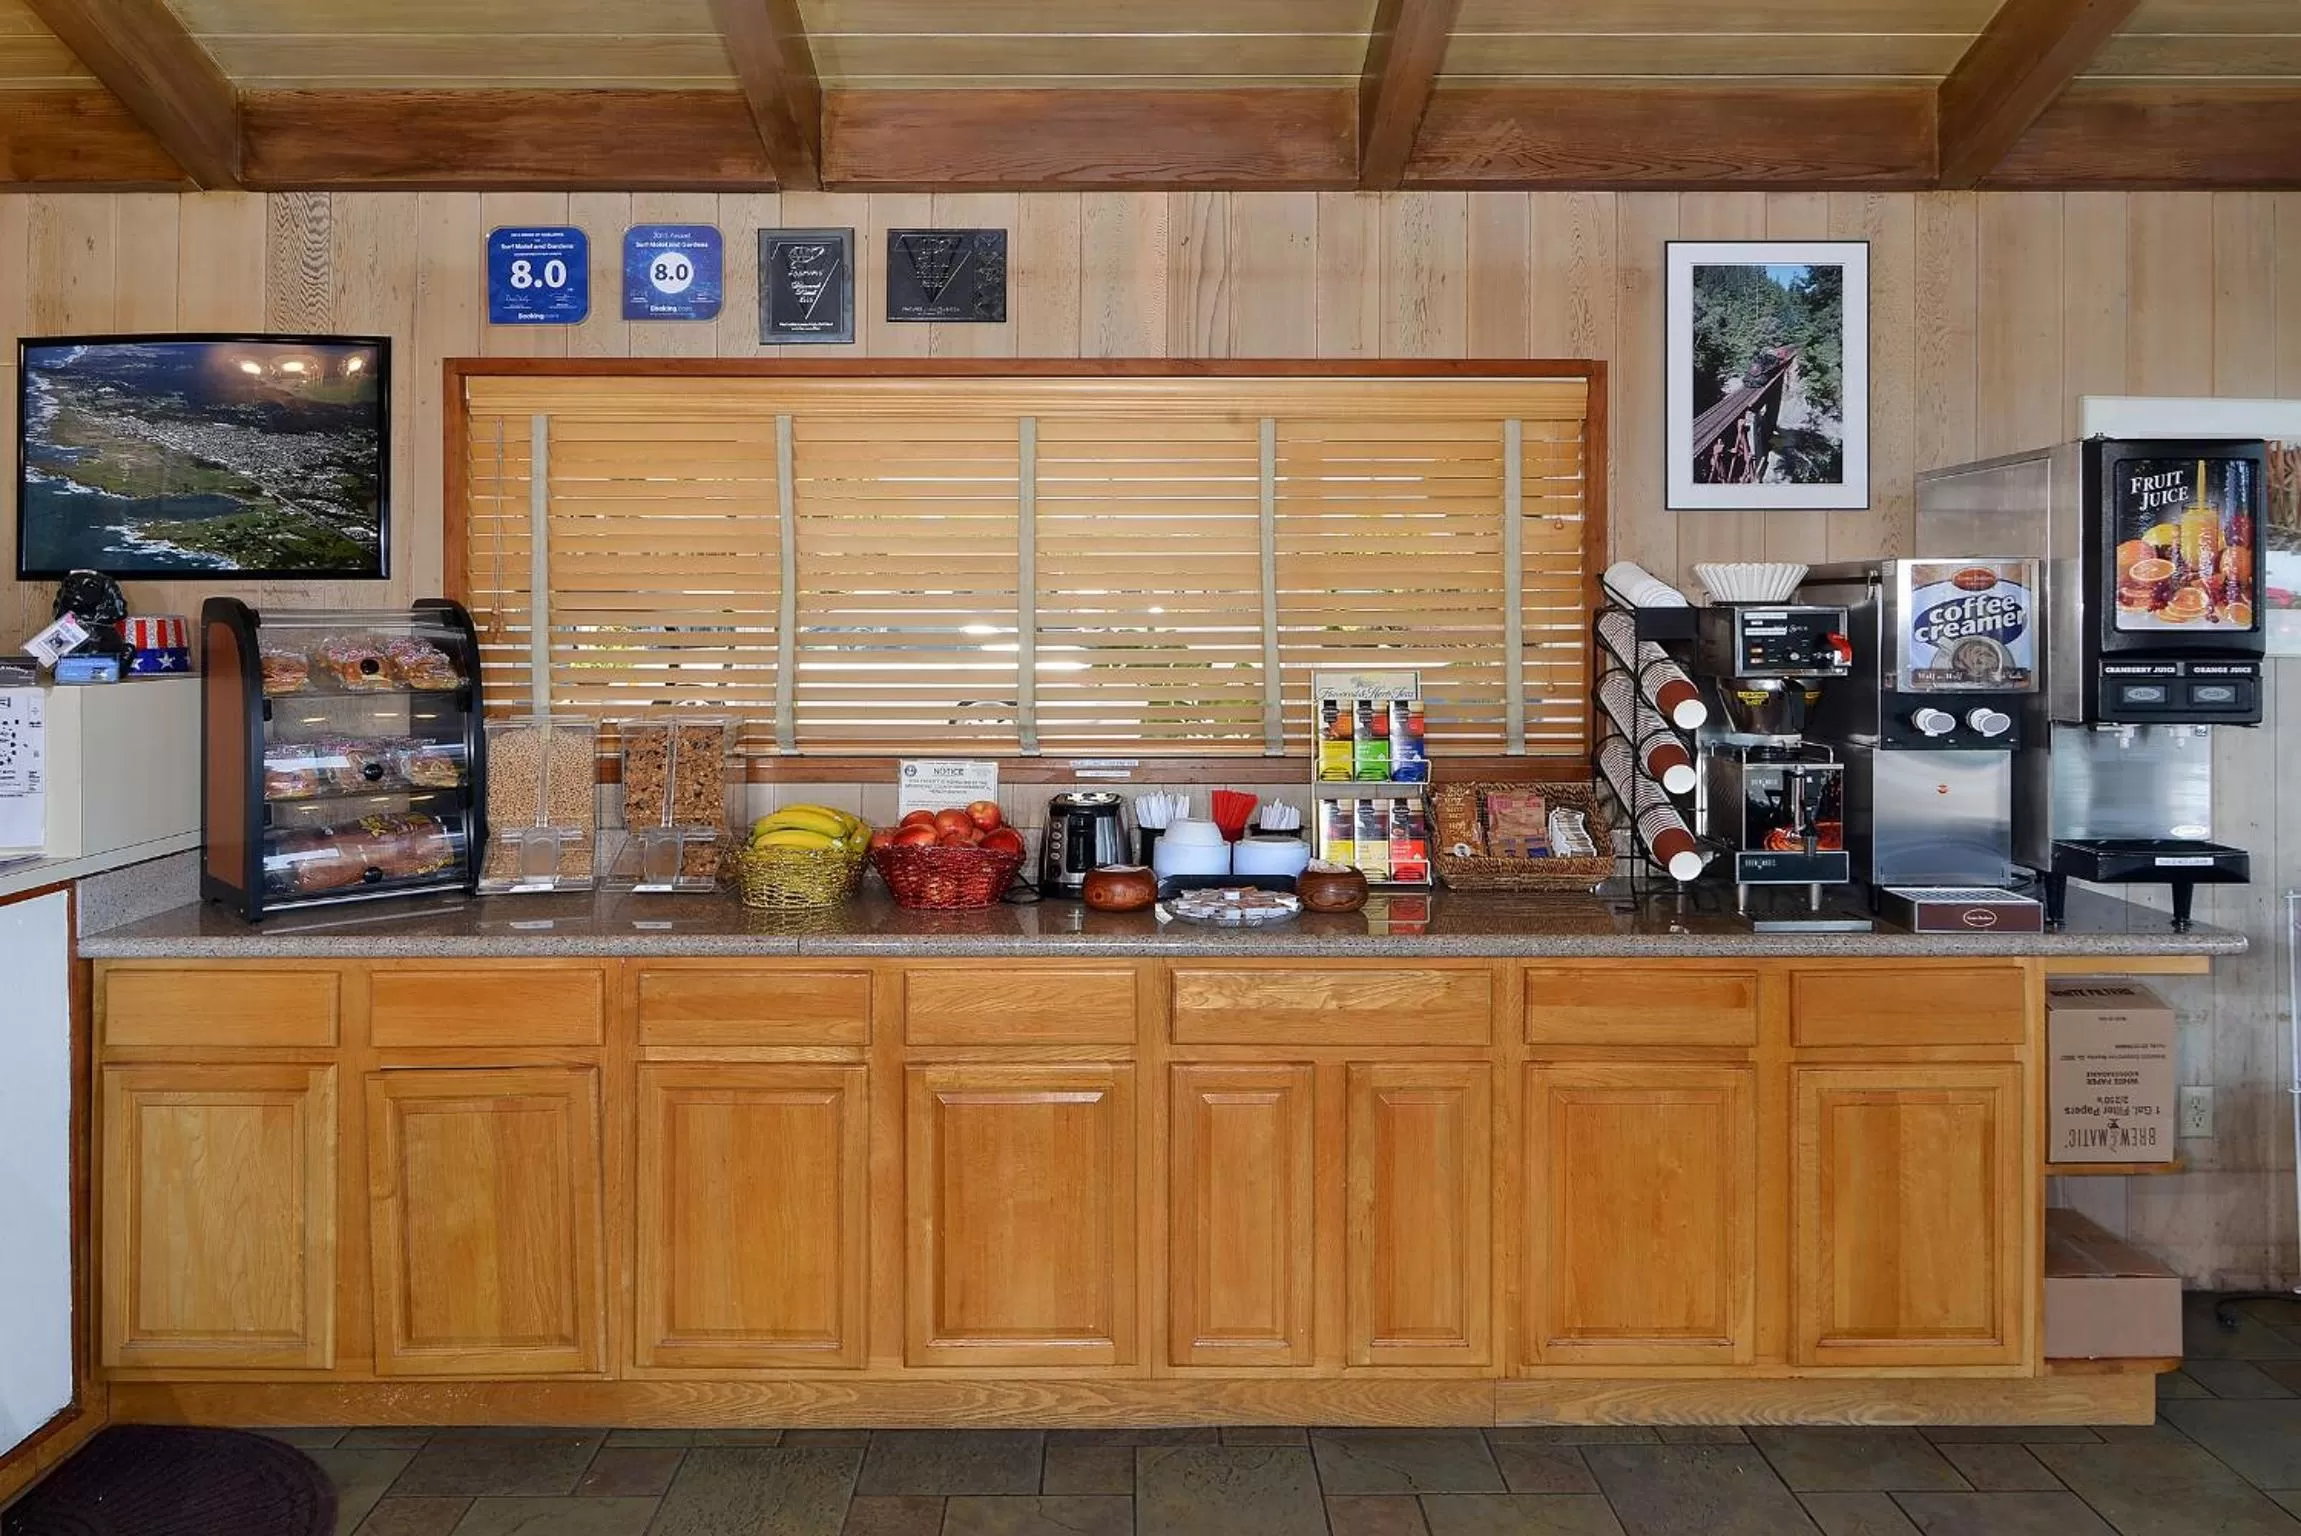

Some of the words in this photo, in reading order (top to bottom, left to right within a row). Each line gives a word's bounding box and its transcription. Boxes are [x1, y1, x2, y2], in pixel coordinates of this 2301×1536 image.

[510, 259, 567, 289] 8.0
[654, 263, 689, 281] 8.0
[2130, 470, 2184, 495] FRUIT
[2139, 486, 2189, 511] JUICE
[1929, 594, 2016, 625] coffee
[1914, 610, 2026, 643] creamer
[2153, 666, 2176, 674] JUICE
[2193, 666, 2228, 674] ORANGE
[2229, 666, 2252, 674] JUICE
[933, 767, 964, 776] NOTICE
[2064, 1104, 2102, 1116] Papers
